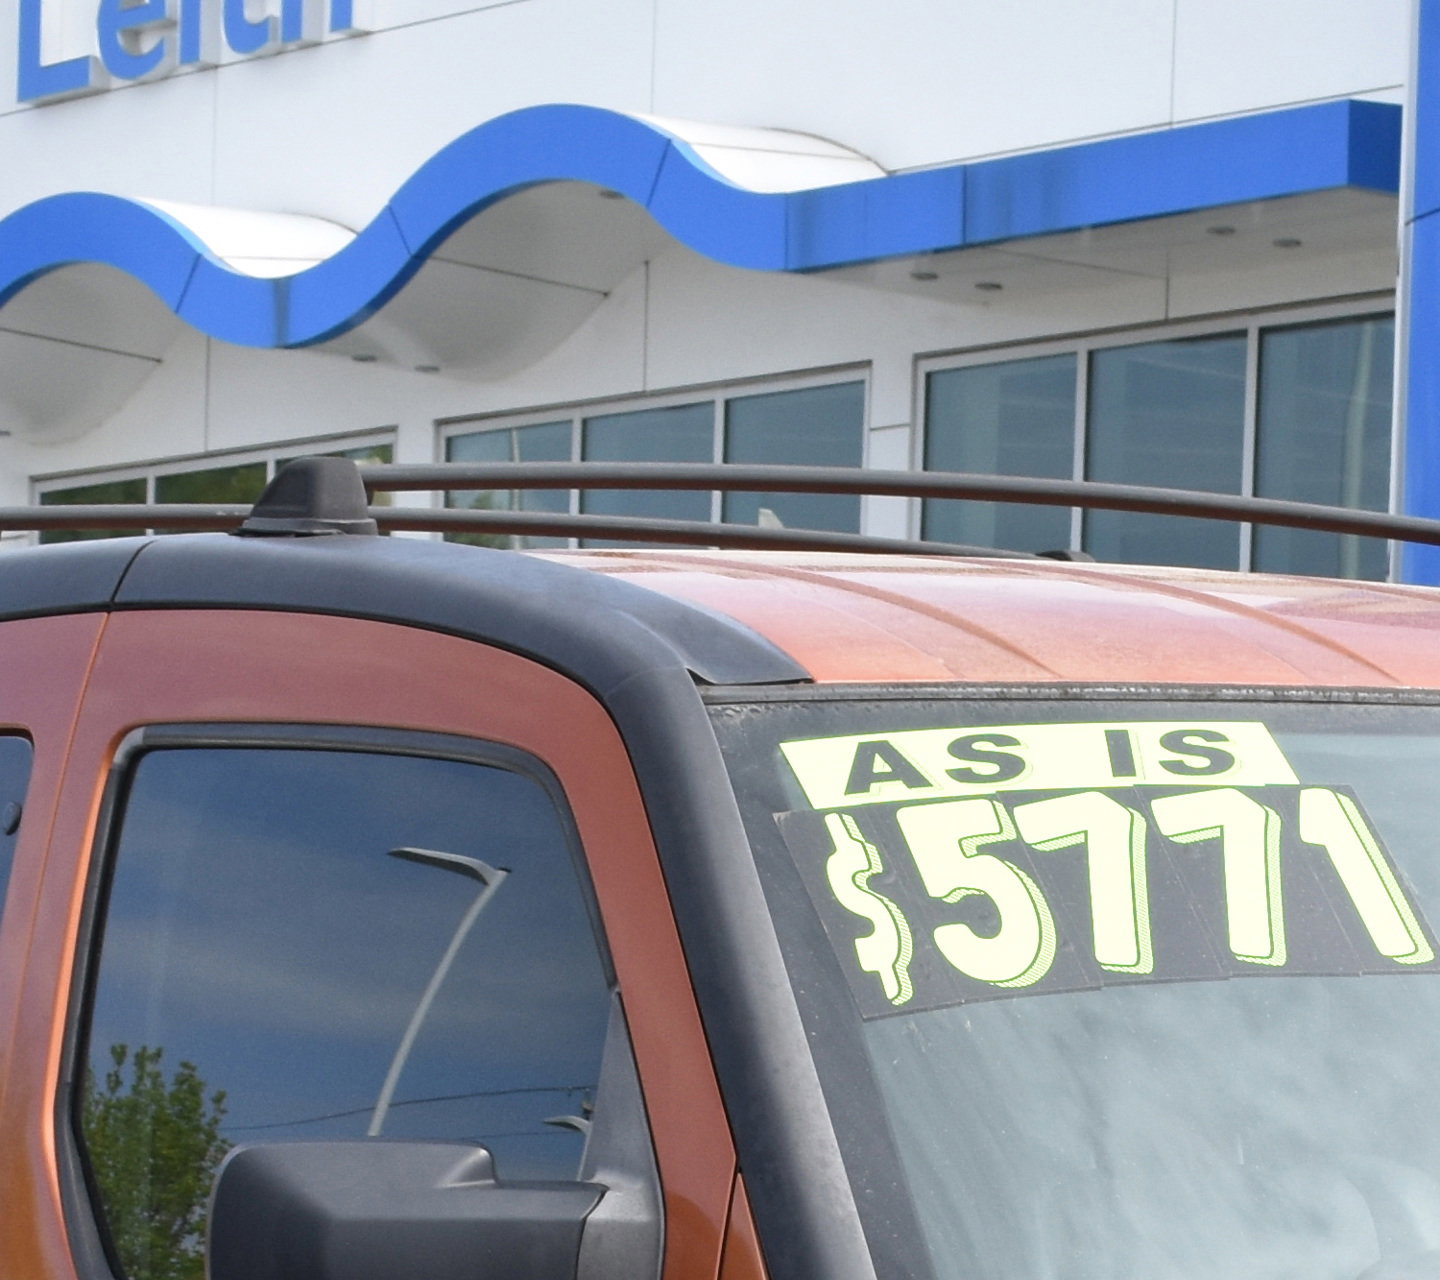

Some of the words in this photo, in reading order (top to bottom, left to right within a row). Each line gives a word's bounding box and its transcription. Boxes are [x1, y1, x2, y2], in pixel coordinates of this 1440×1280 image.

[17, 0, 355, 101] Lei
[843, 733, 1028, 796] AS
[1104, 728, 1237, 778] IS
[823, 787, 1434, 1006] $5771
